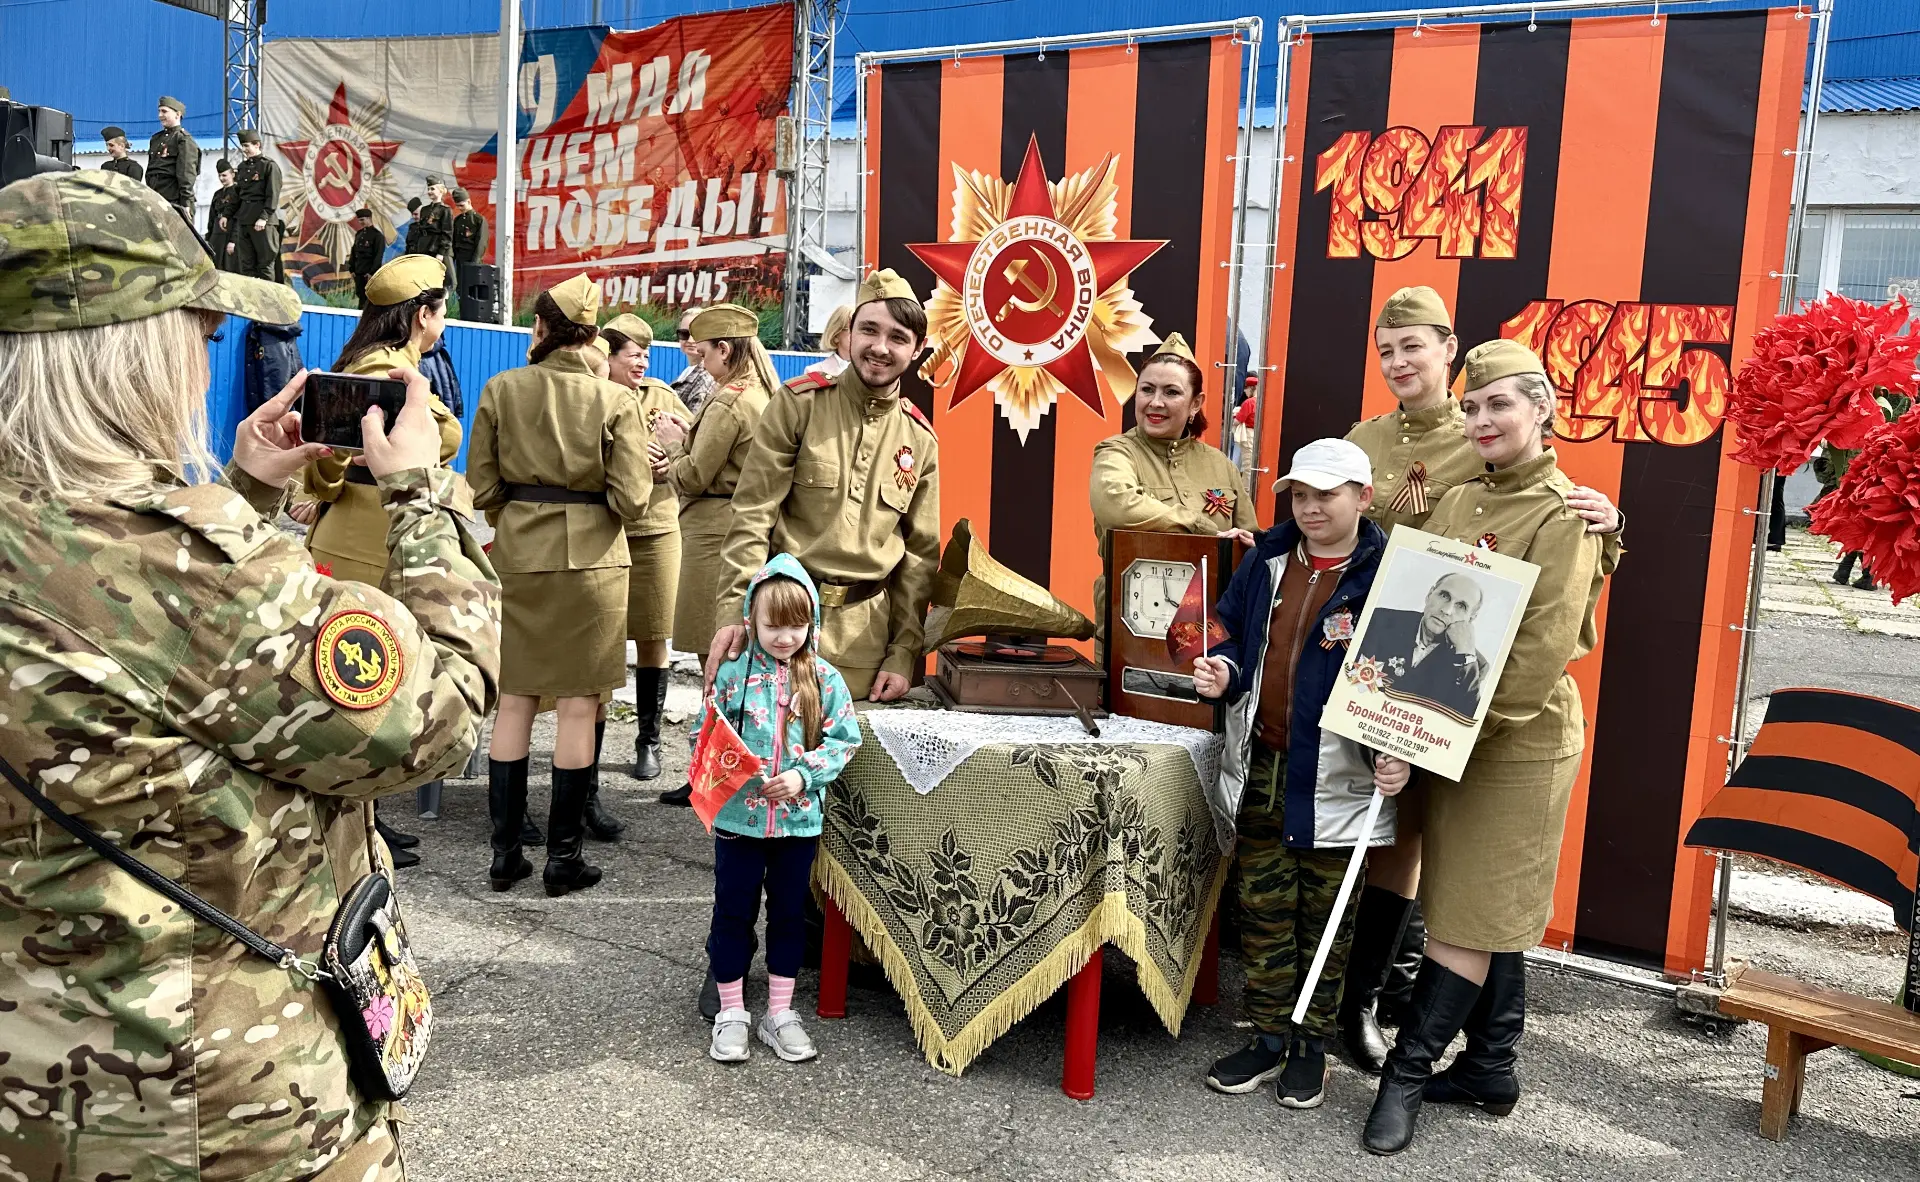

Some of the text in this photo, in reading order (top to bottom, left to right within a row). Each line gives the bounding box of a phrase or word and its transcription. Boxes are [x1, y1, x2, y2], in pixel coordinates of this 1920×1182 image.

[518, 48, 712, 134] 9 МАЯ
[1314, 125, 1529, 261] 1941
[526, 169, 780, 253] ПОБЕДЫ!
[597, 270, 730, 308] 1941-1945
[969, 221, 1084, 351] ОТЕЧЕСТВЕННАЯ
[1151, 566, 1158, 575] 11
[1164, 567, 1173, 577] 12
[1182, 569, 1186, 577] 1
[1133, 591, 1139, 600] 9
[1132, 611, 1139, 620] 8
[1149, 620, 1156, 629] 7
[320, 615, 377, 692] МОРСКАЯ ПЕХОТА РОССИИ
[1346, 700, 1451, 750] Бронислав Ильич
[1381, 700, 1424, 725] Китаев
[1361, 732, 1416, 759] МЛАДШИЙ ЛЕЙТЕНАНТ
[1395, 735, 1430, 755] 17.02.1987
